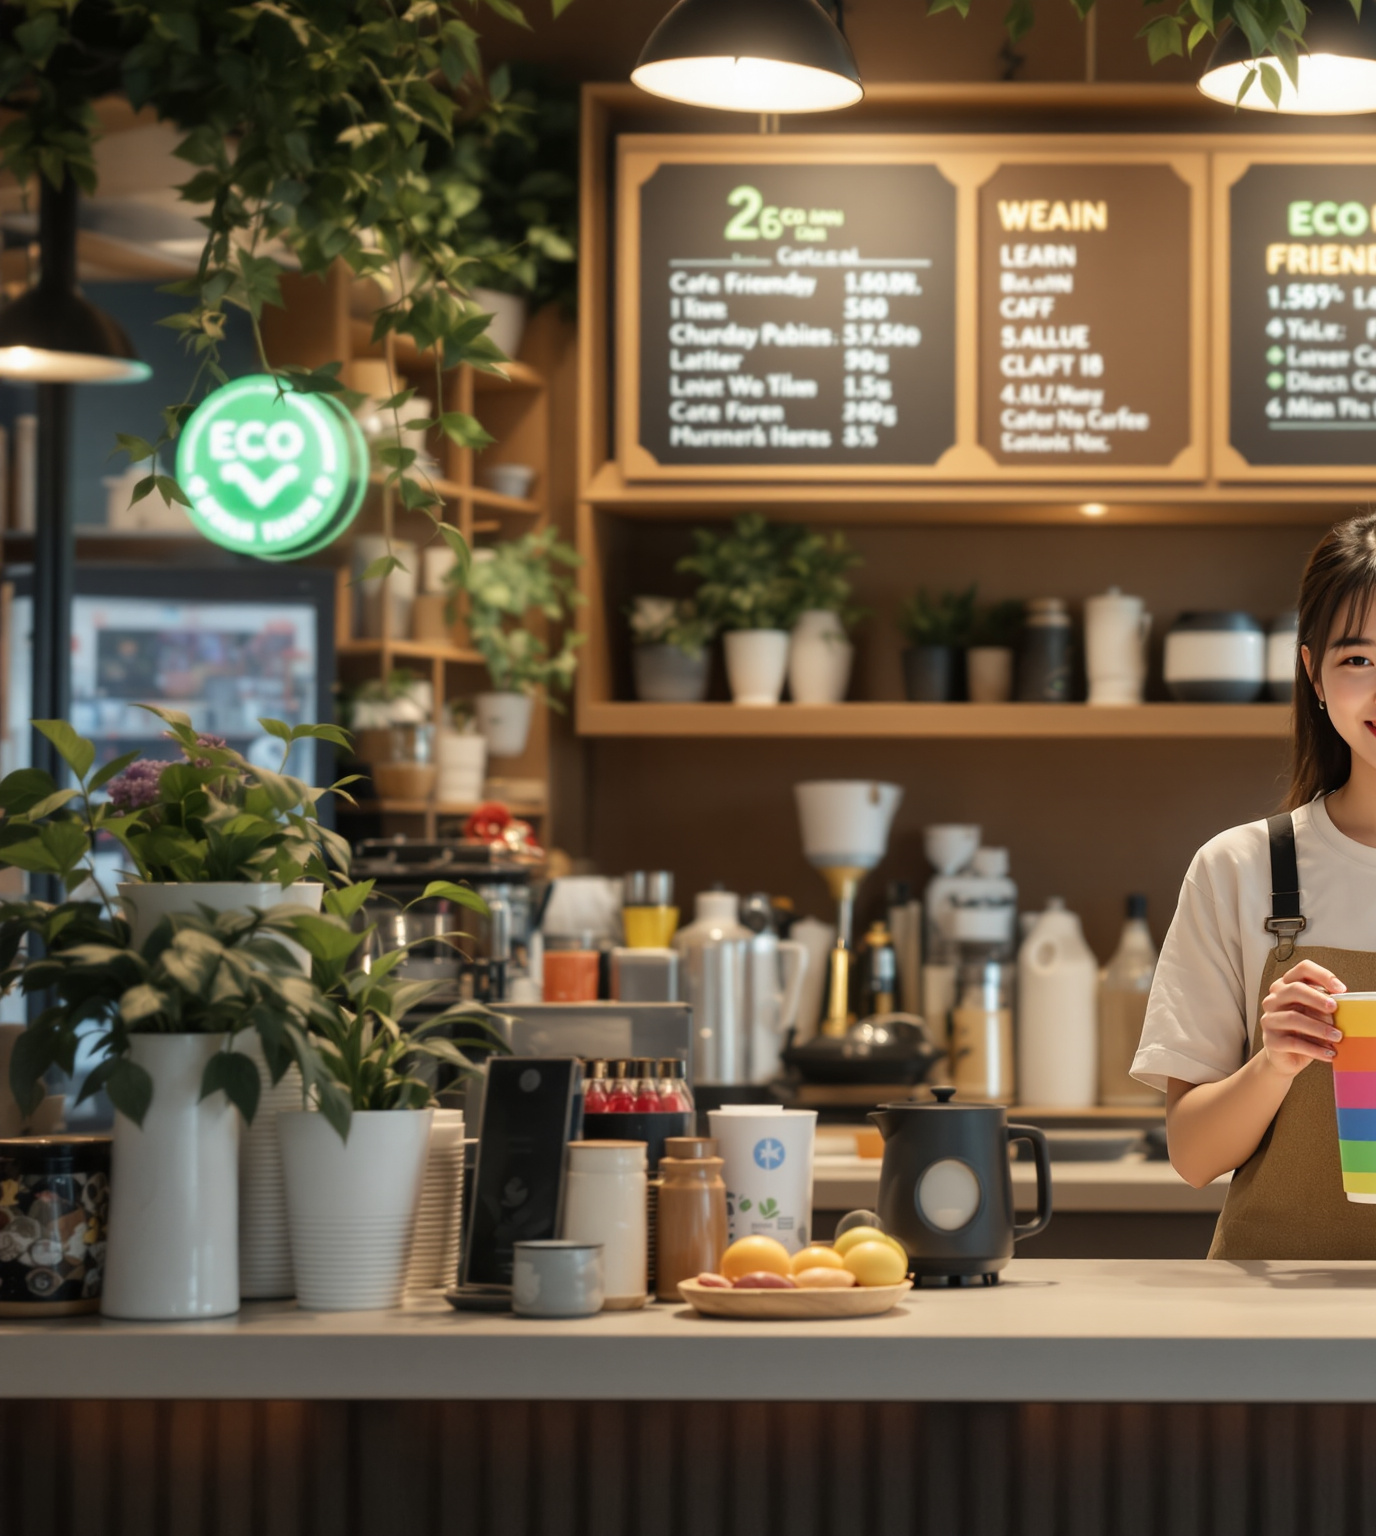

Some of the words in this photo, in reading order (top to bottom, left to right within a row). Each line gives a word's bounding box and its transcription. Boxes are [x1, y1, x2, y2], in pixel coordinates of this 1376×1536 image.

[998, 199, 1107, 232] WEAIN
[1288, 201, 1369, 237] ECO
[1000, 244, 1076, 269] LEARN
[209, 420, 305, 461] ECO
